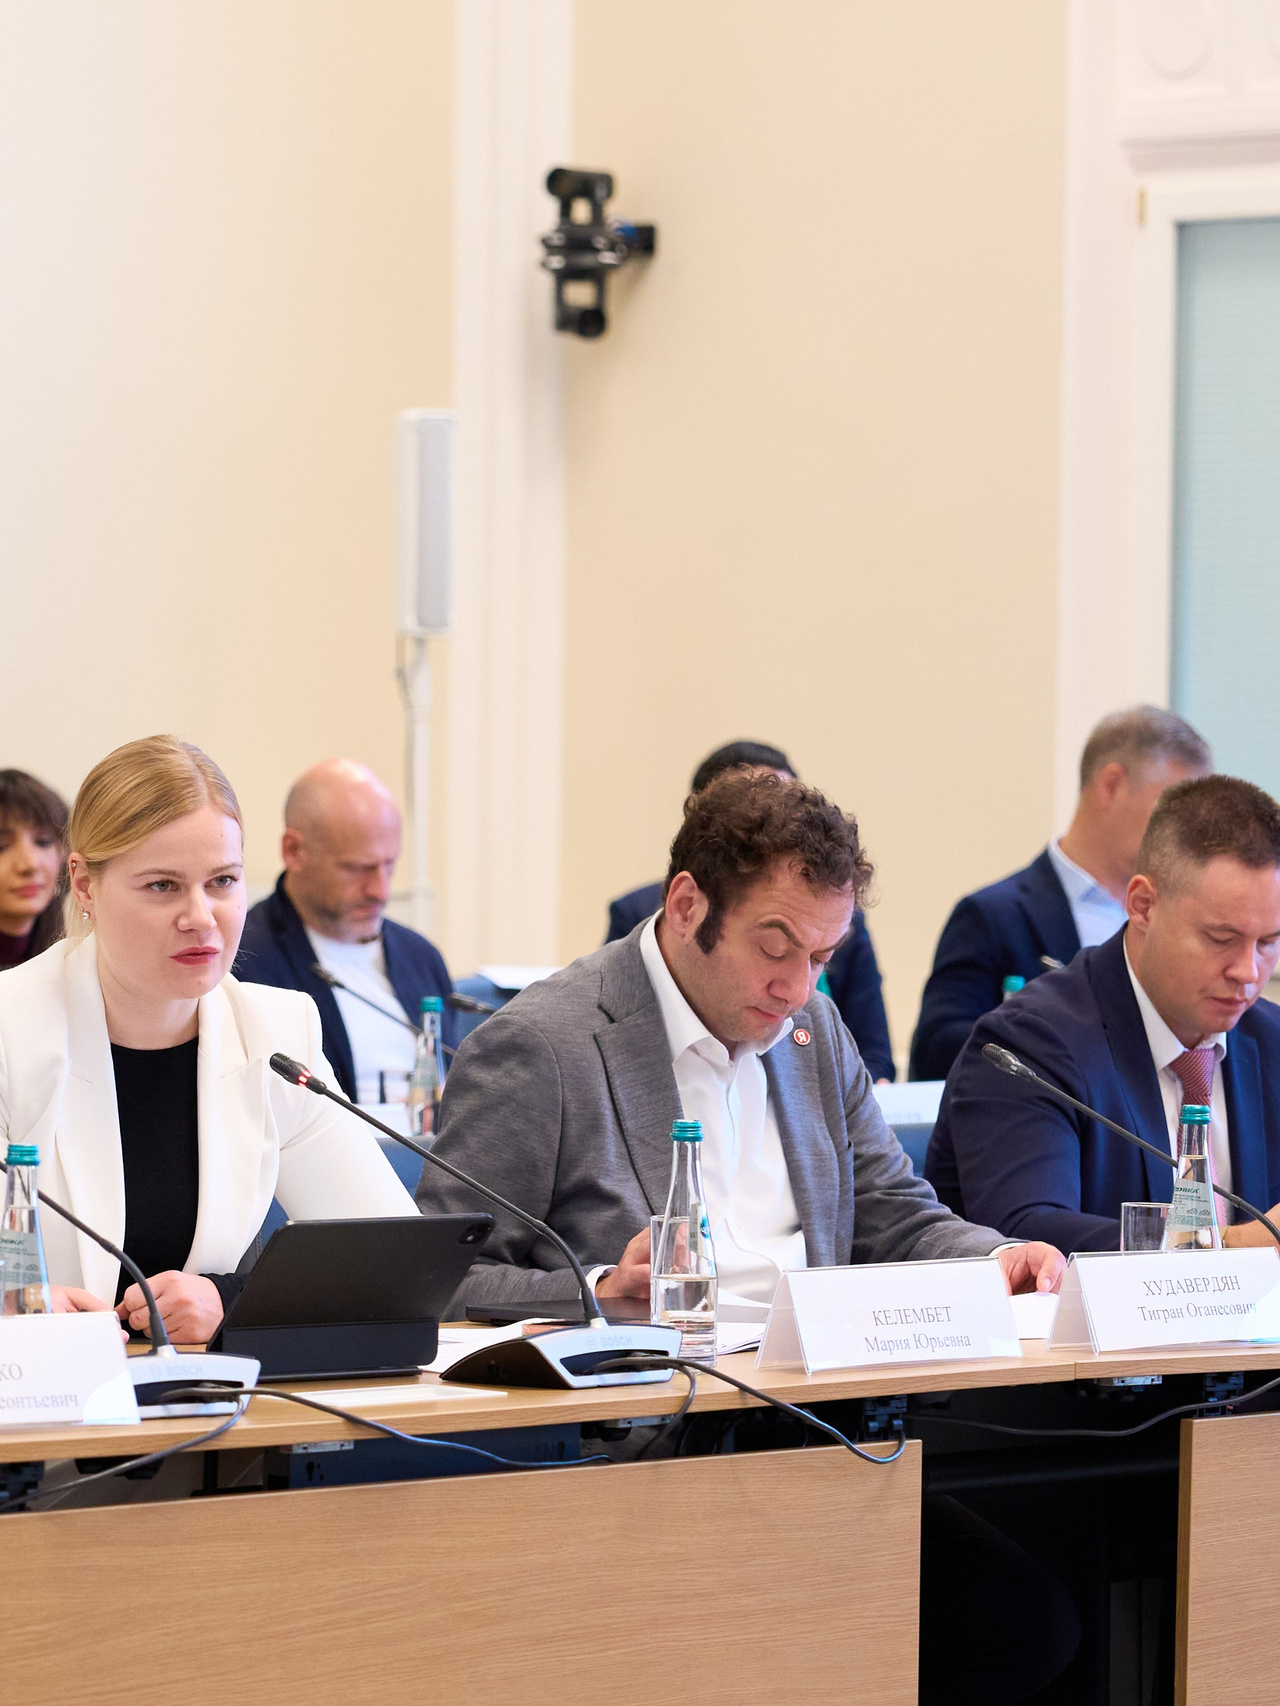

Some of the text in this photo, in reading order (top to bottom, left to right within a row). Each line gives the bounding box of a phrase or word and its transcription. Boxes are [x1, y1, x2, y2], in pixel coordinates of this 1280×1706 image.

[1142, 1275, 1241, 1297] ХУДАВЕРДЯН
[872, 1306, 952, 1326] КЕЛЕМБЕТ
[1137, 1301, 1258, 1324] Тигран Оганесович
[600, 1336, 633, 1347] BOSCH
[864, 1333, 972, 1355] Мария Юрьевна
